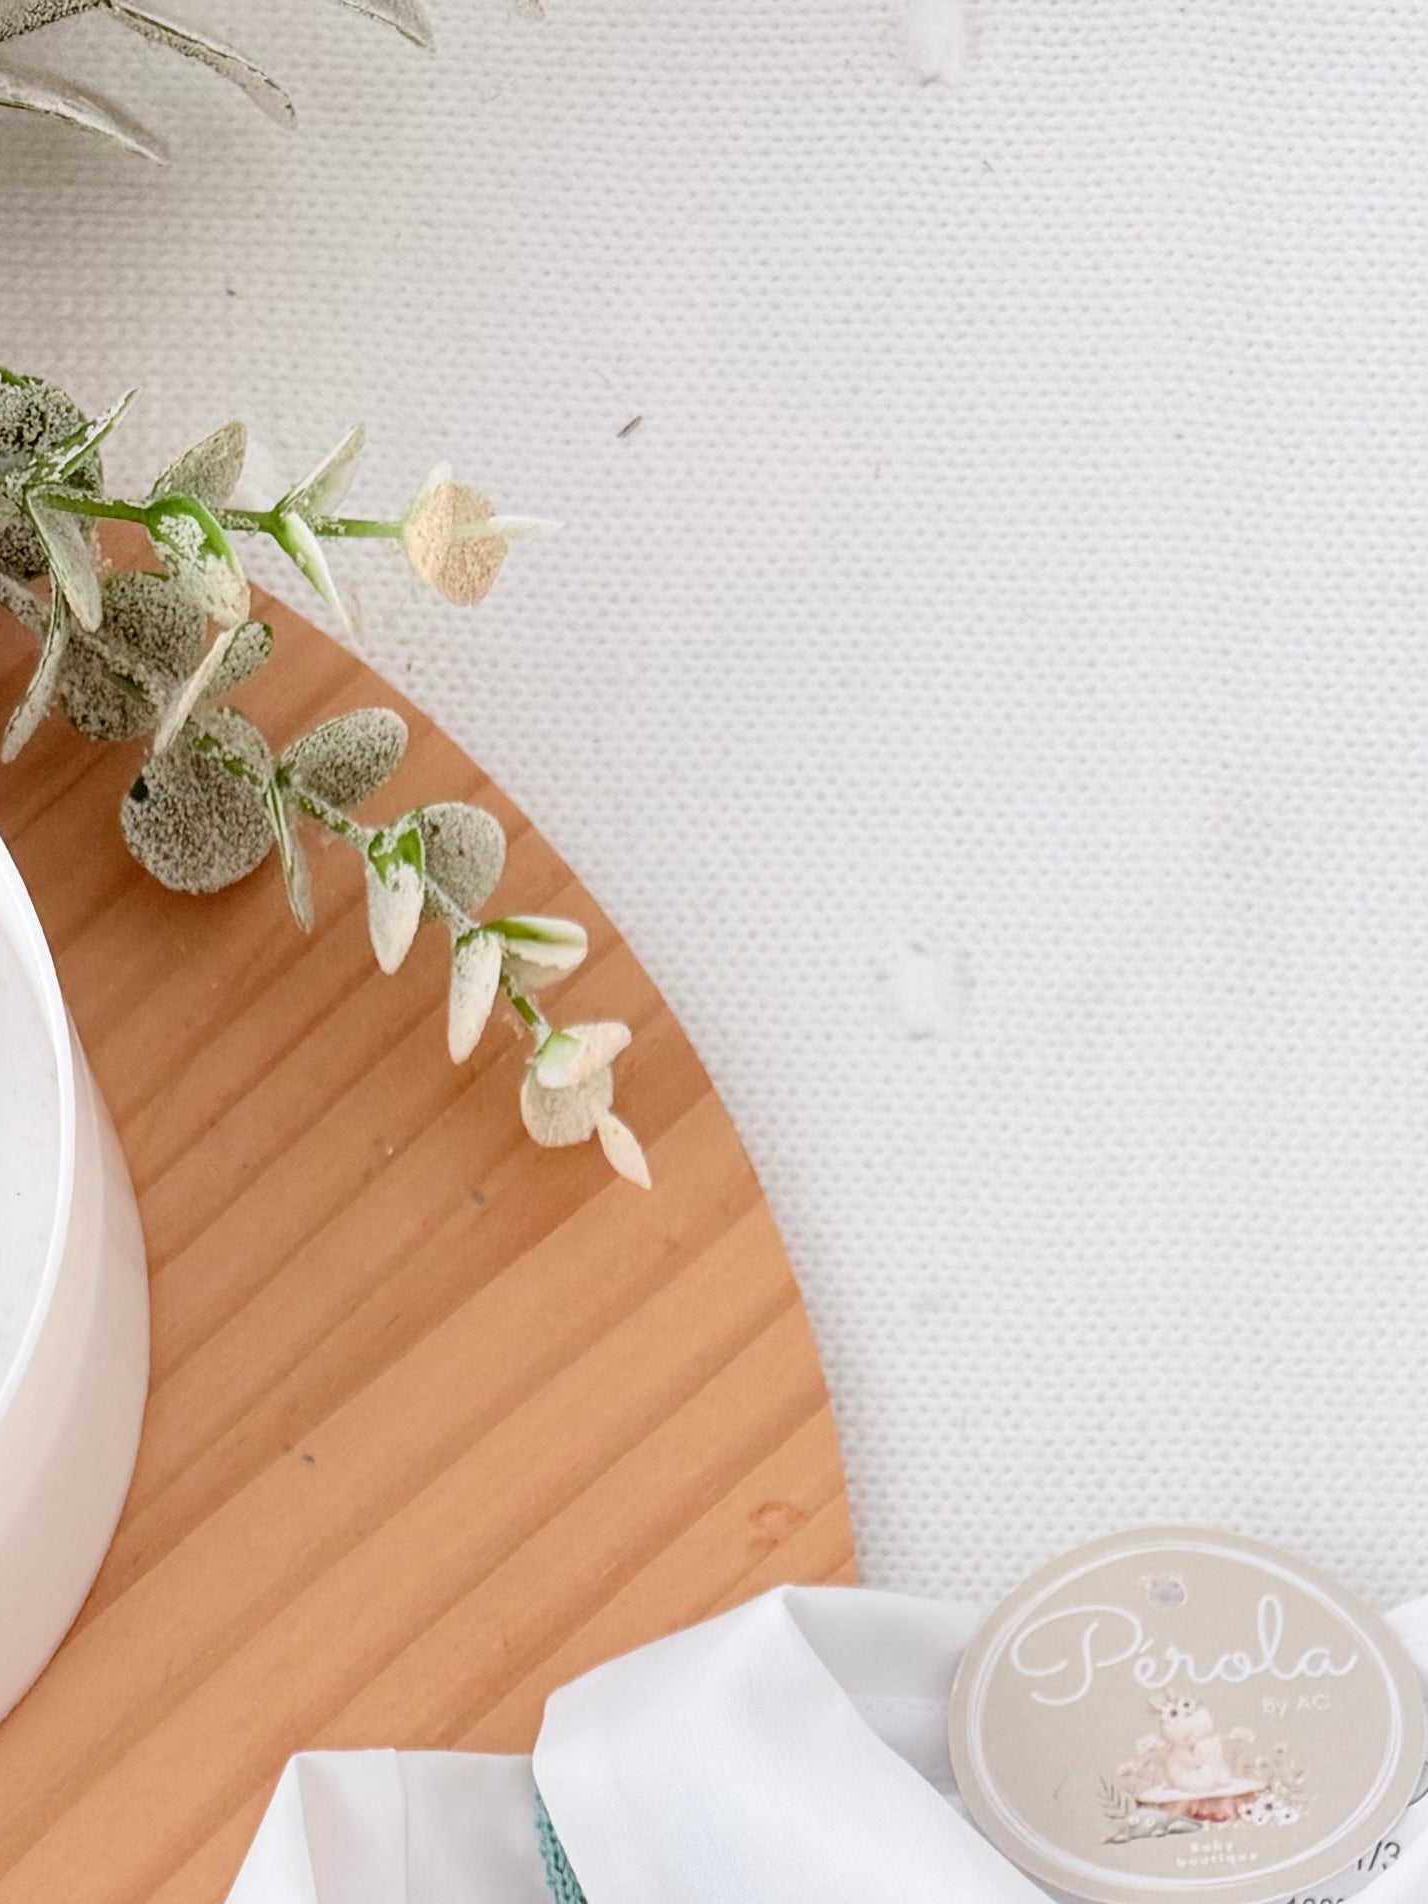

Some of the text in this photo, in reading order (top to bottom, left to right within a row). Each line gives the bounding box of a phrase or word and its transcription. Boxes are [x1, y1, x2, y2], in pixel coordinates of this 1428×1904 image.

[1009, 1594, 1358, 1707] Pérola
[1261, 1694, 1332, 1718] By AC
